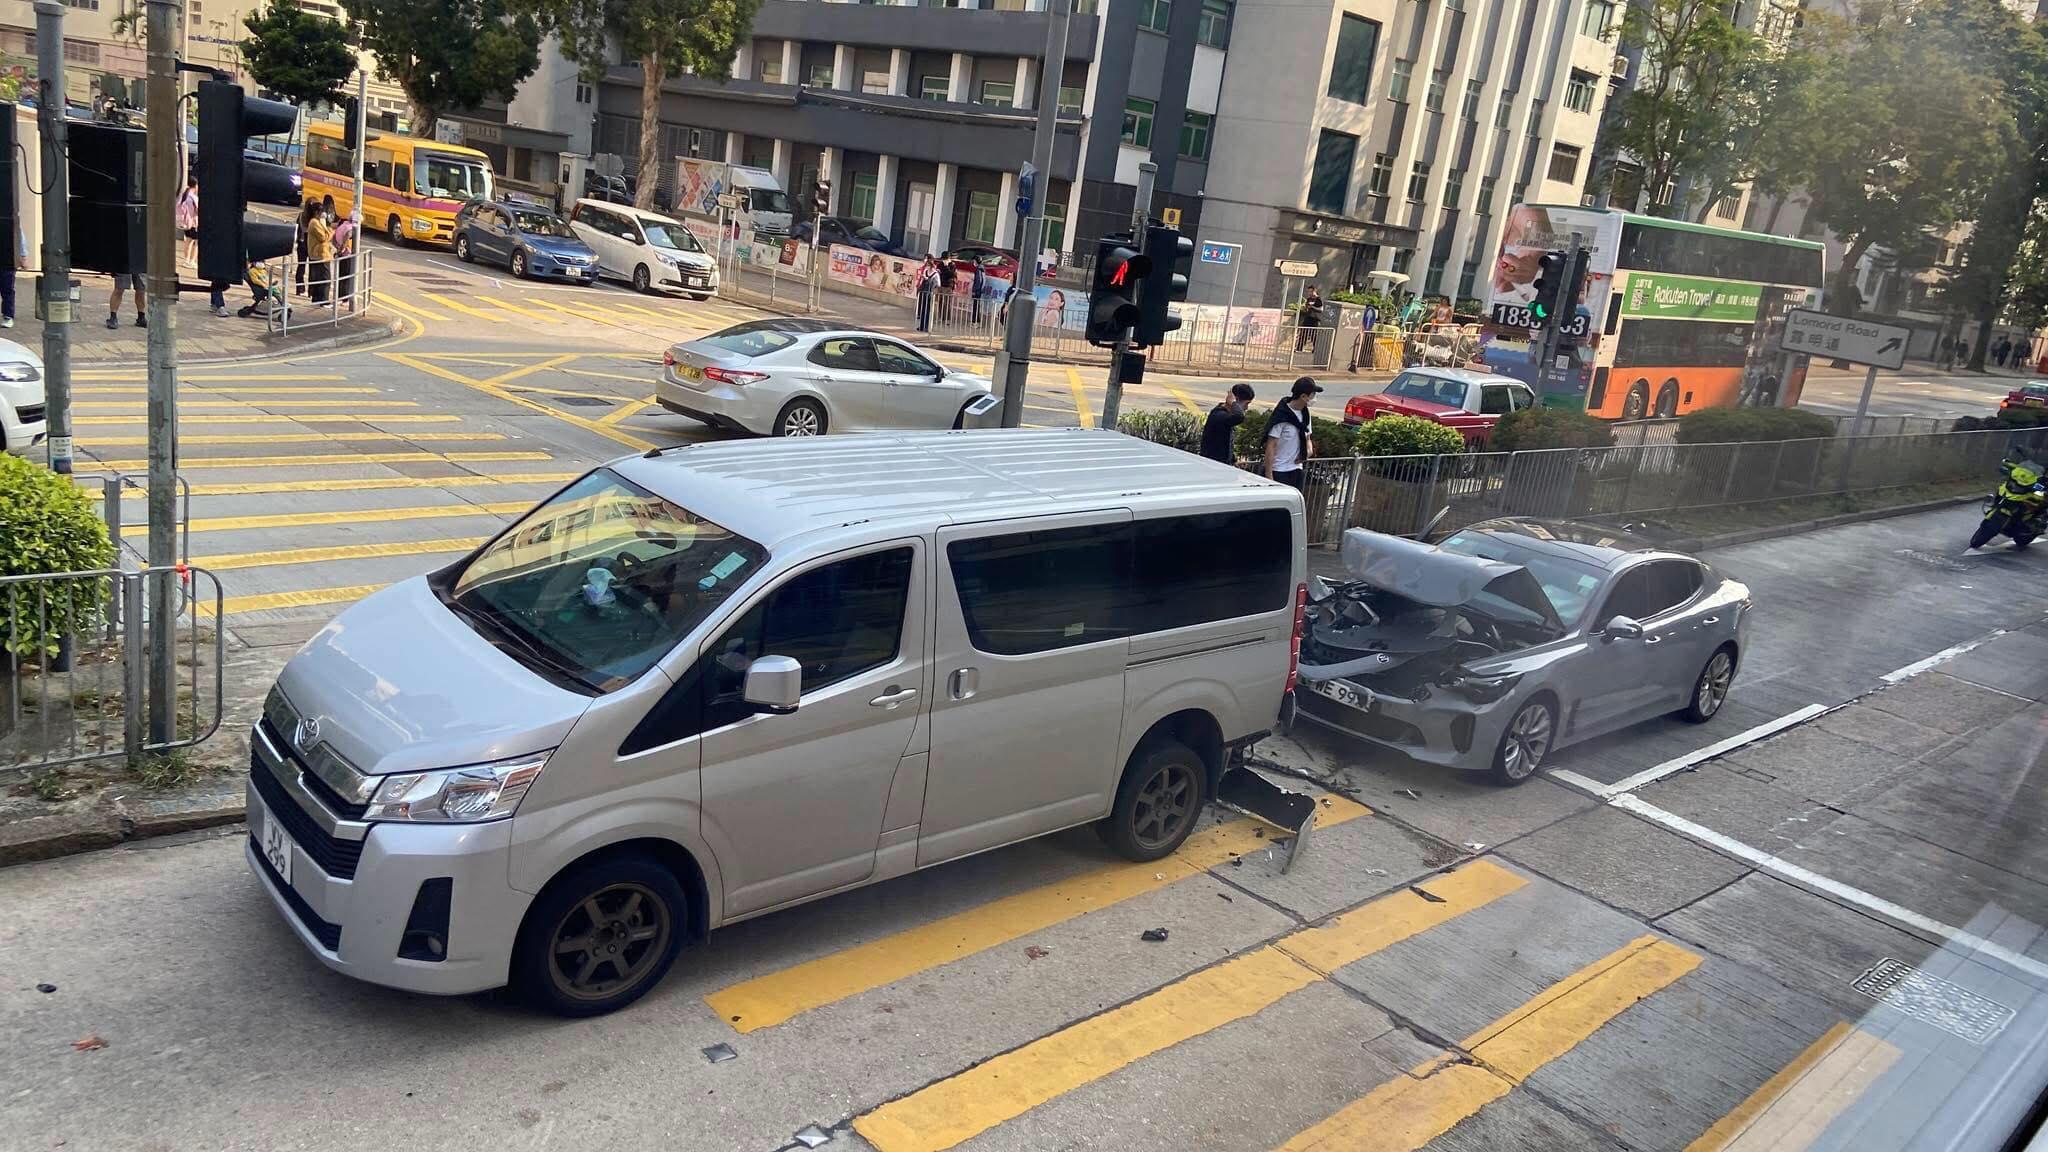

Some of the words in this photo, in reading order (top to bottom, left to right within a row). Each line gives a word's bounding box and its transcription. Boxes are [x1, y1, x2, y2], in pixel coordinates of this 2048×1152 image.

[1653, 285, 1688, 304] Rakuten
[1689, 289, 1714, 306] Travel
[1792, 314, 1842, 331] Lomond
[1846, 323, 1879, 338] Road
